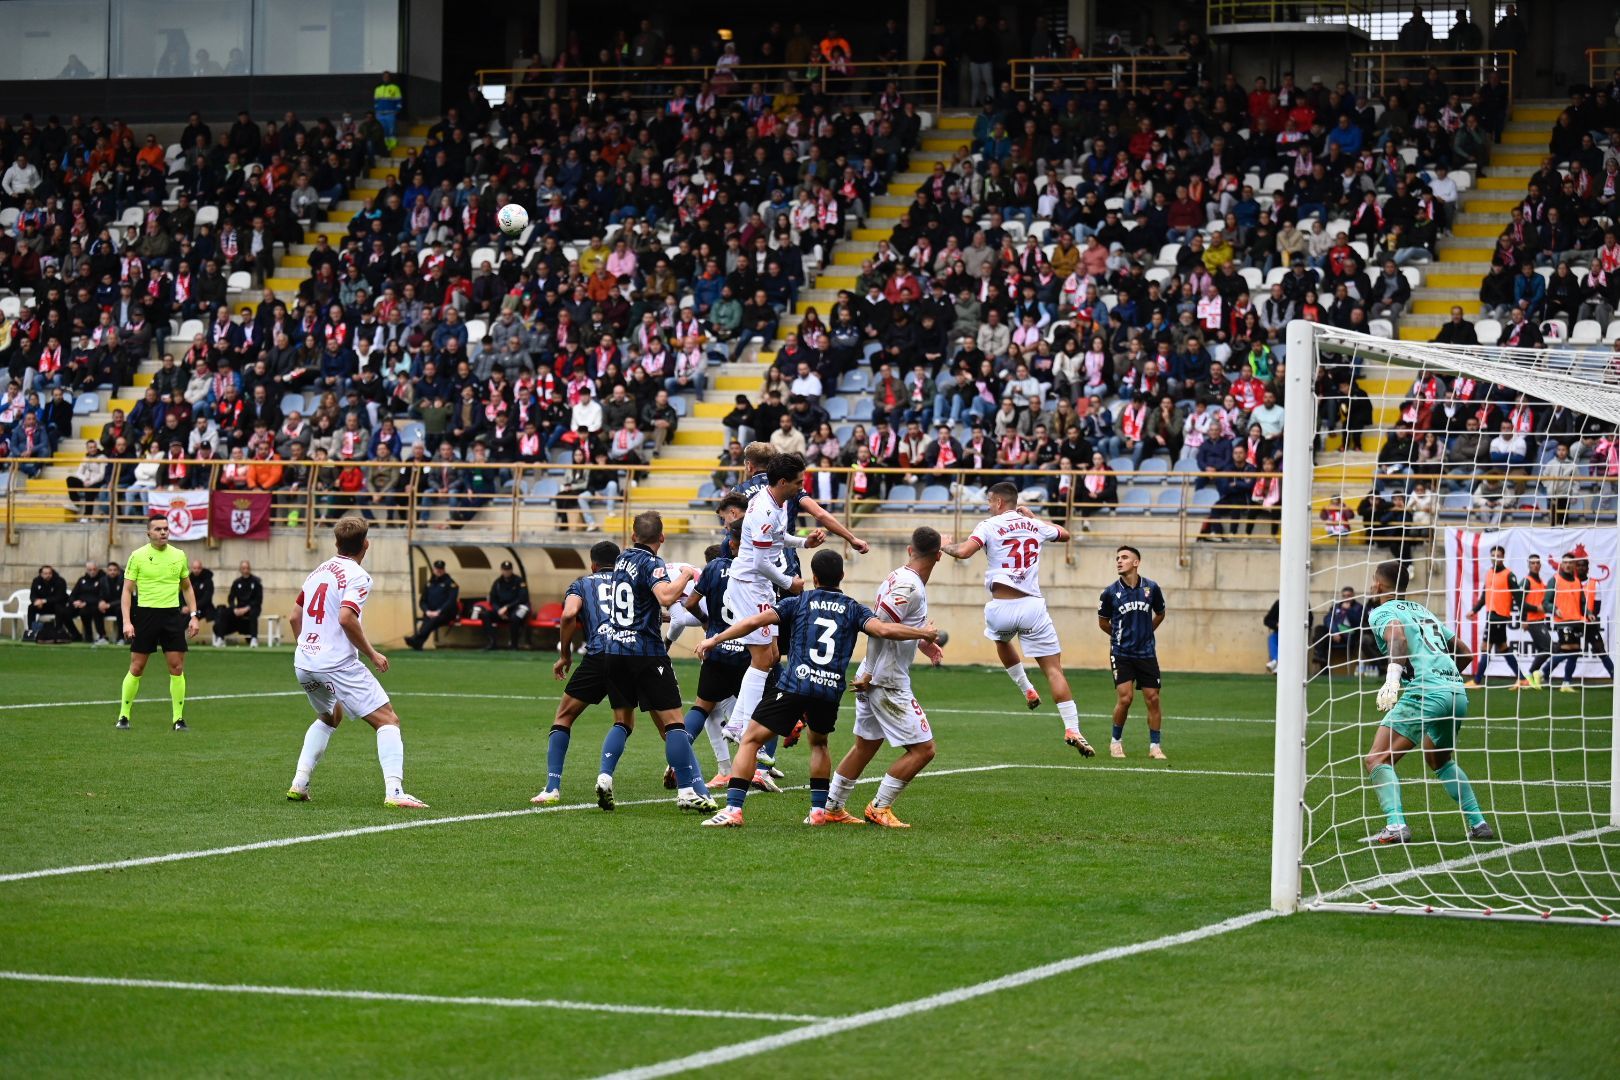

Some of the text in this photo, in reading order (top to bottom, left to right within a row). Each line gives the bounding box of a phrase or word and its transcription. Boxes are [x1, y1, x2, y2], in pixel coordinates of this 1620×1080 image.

[1002, 538, 1039, 569] 36
[306, 582, 329, 625] 4
[809, 600, 846, 614] MATOS
[1118, 600, 1150, 615] CEUTA
[809, 617, 838, 665] 3
[1411, 617, 1450, 655] 13
[809, 675, 838, 688] MOTOR
